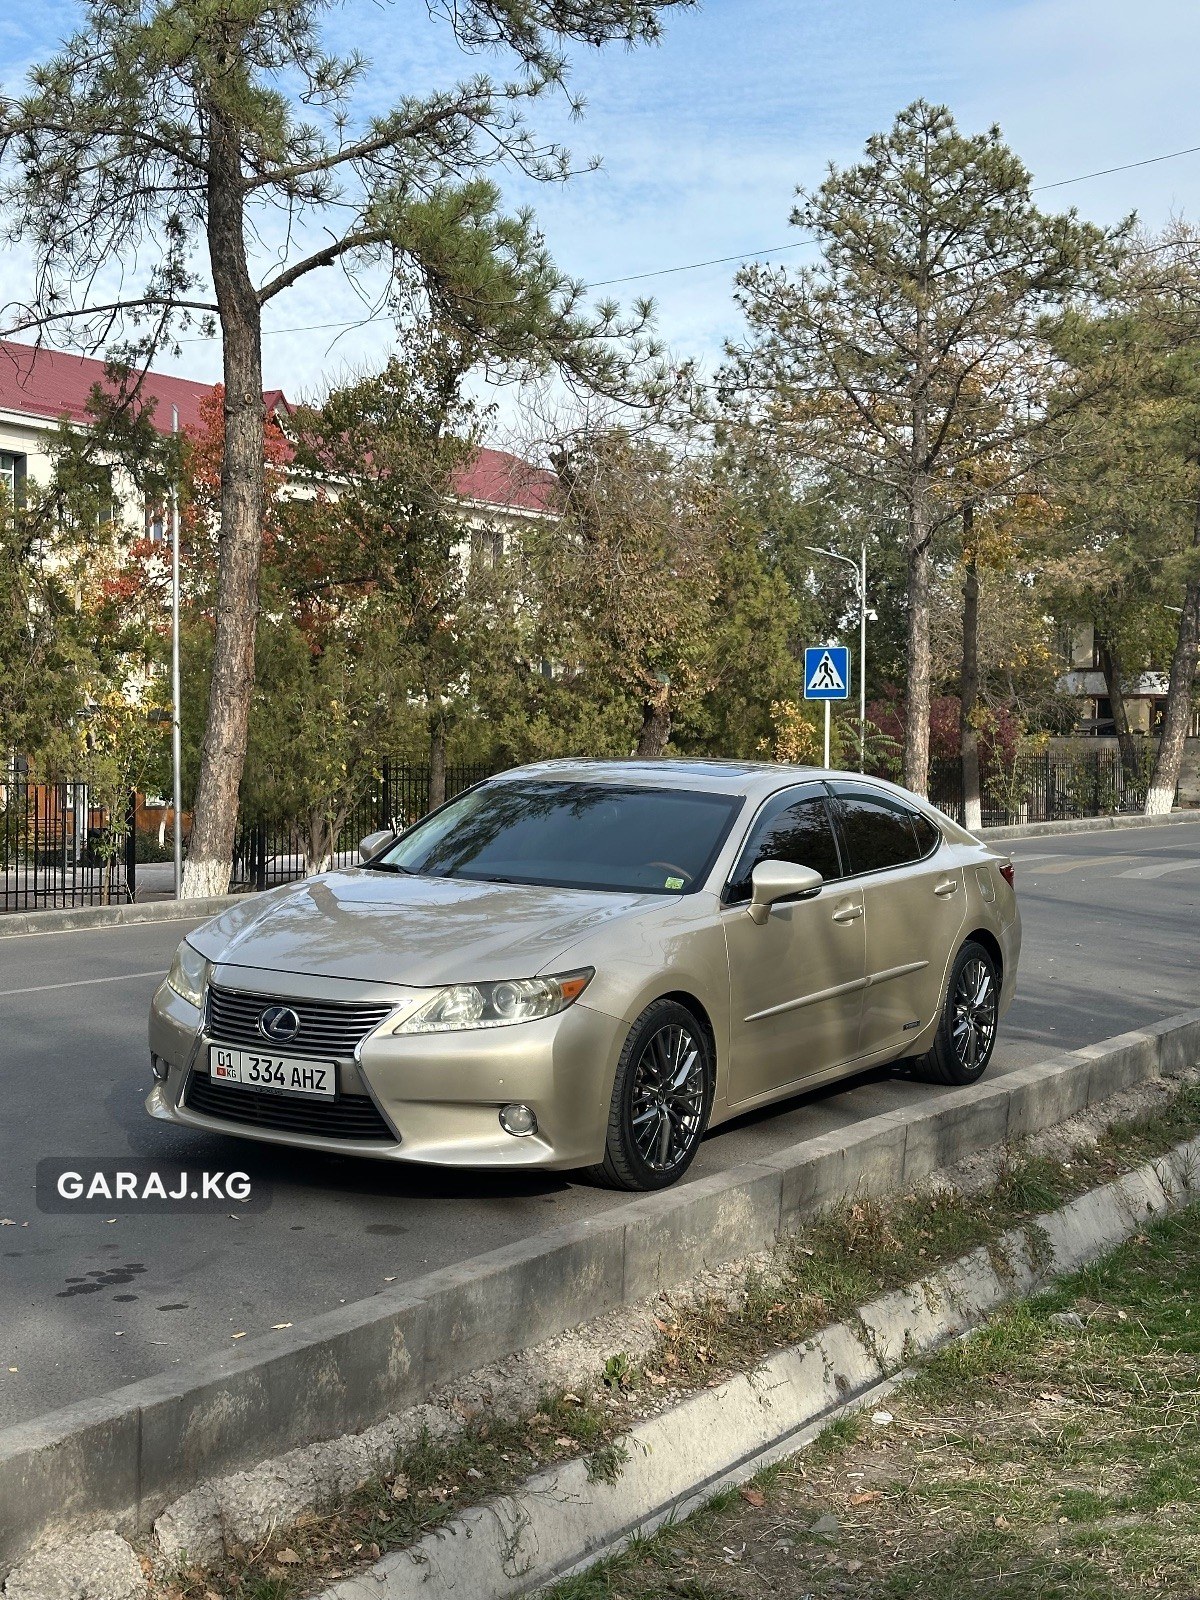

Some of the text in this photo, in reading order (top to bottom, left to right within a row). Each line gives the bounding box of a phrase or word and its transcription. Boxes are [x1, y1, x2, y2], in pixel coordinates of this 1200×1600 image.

[217, 1051, 327, 1091] 01 334 AHZ
[226, 1068, 237, 1079] KG
